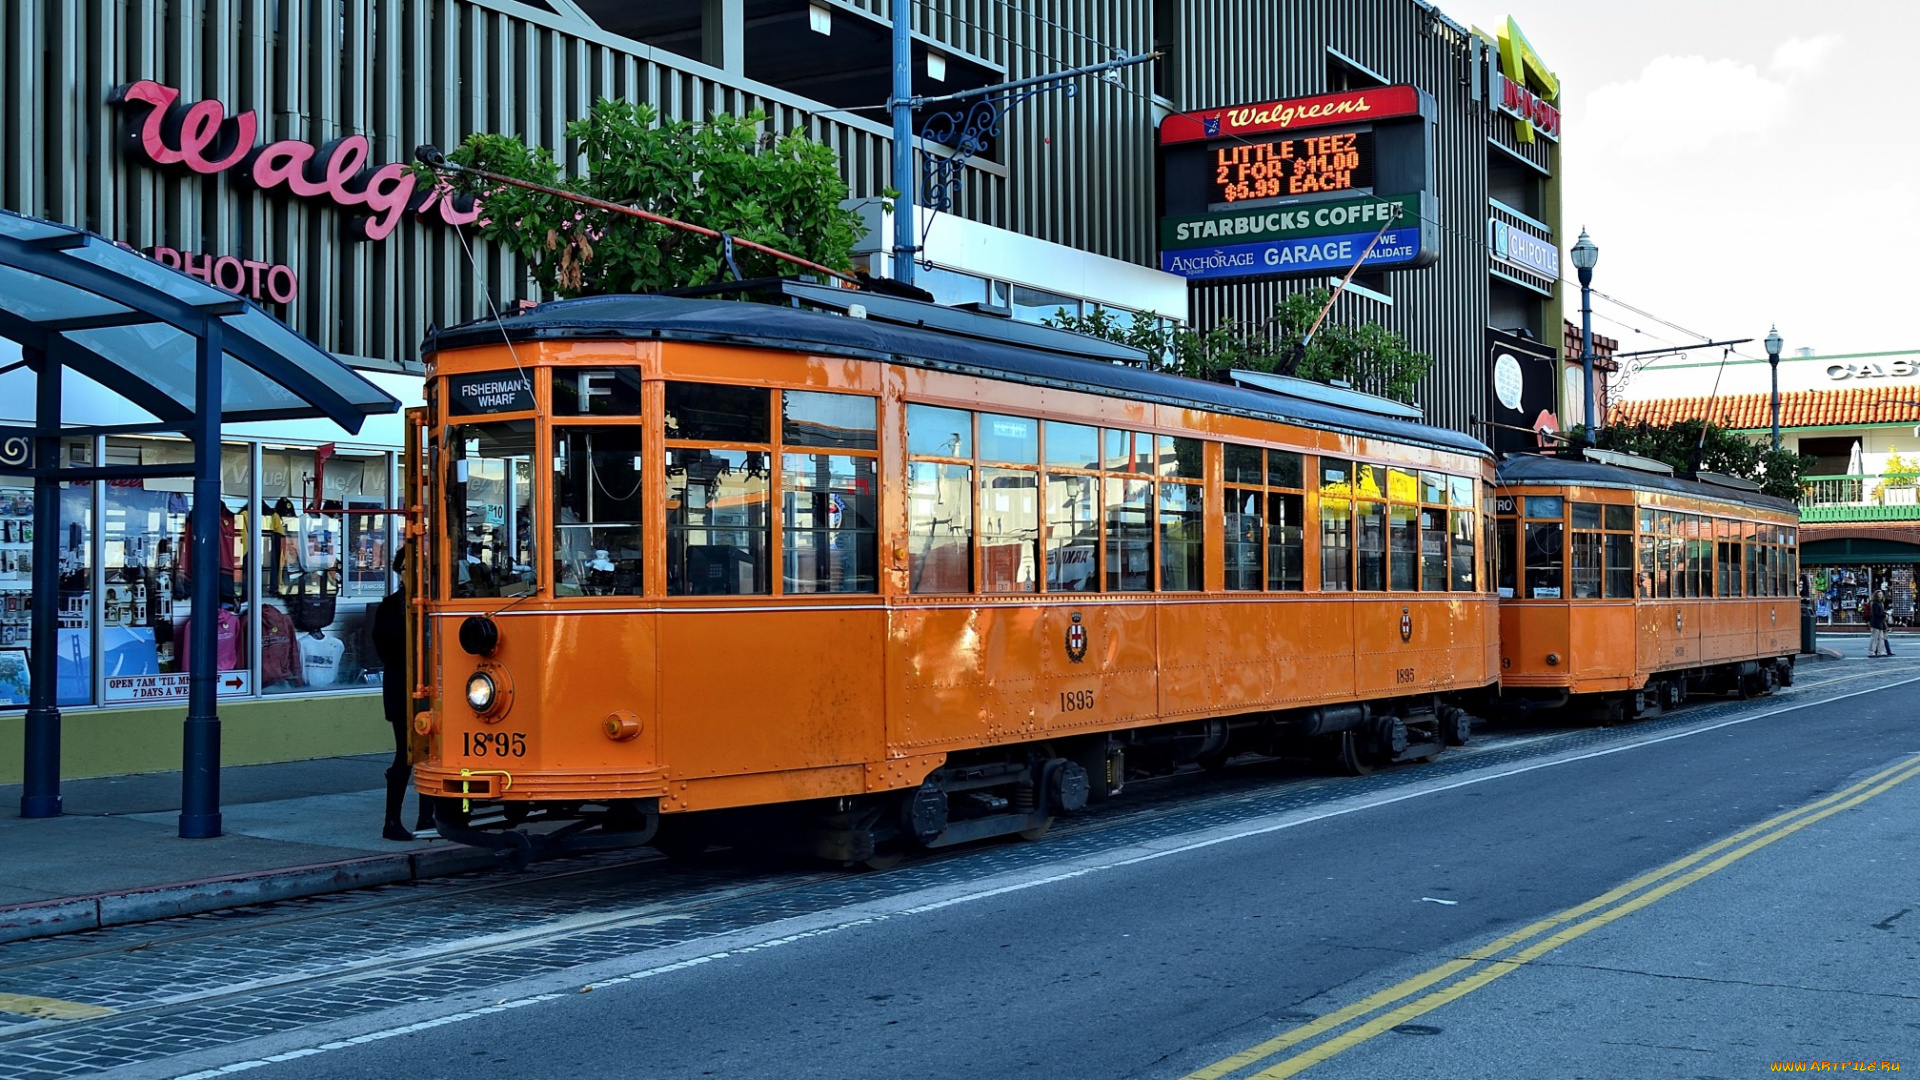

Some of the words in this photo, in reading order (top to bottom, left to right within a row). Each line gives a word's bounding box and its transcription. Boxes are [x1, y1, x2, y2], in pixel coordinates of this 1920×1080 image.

[1227, 96, 1371, 128] Walgreens
[1217, 140, 1294, 166] LITTLE
[1303, 133, 1357, 155] TEEZ
[1217, 166, 1229, 184] 2
[1238, 160, 1283, 181] FOR
[1294, 151, 1360, 177] $11.00
[1224, 177, 1280, 203] $5.99
[1289, 170, 1351, 195] EACH
[1177, 208, 1309, 241] STARBUCKS
[1314, 201, 1404, 227] COFFEE
[1380, 234, 1397, 245] WE
[1170, 253, 1255, 272] ANCHORAGE
[1264, 241, 1352, 266] GARAGE
[1511, 234, 1558, 272] CHIPOTLE
[462, 379, 531, 397] FISHERMAN'S
[478, 392, 516, 408] WHARF
[578, 371, 616, 412] F
[232, 464, 289, 487] Vue!
[109, 679, 133, 688] OPEN
[137, 678, 156, 687] 7AM
[159, 676, 176, 686] 'TIL
[1395, 668, 1415, 685] 1895
[133, 689, 138, 697] 7
[141, 688, 164, 697] DAYS
[166, 687, 173, 695] A
[175, 686, 189, 695] WE
[1060, 690, 1094, 712] 1895
[463, 731, 527, 758] 1895
